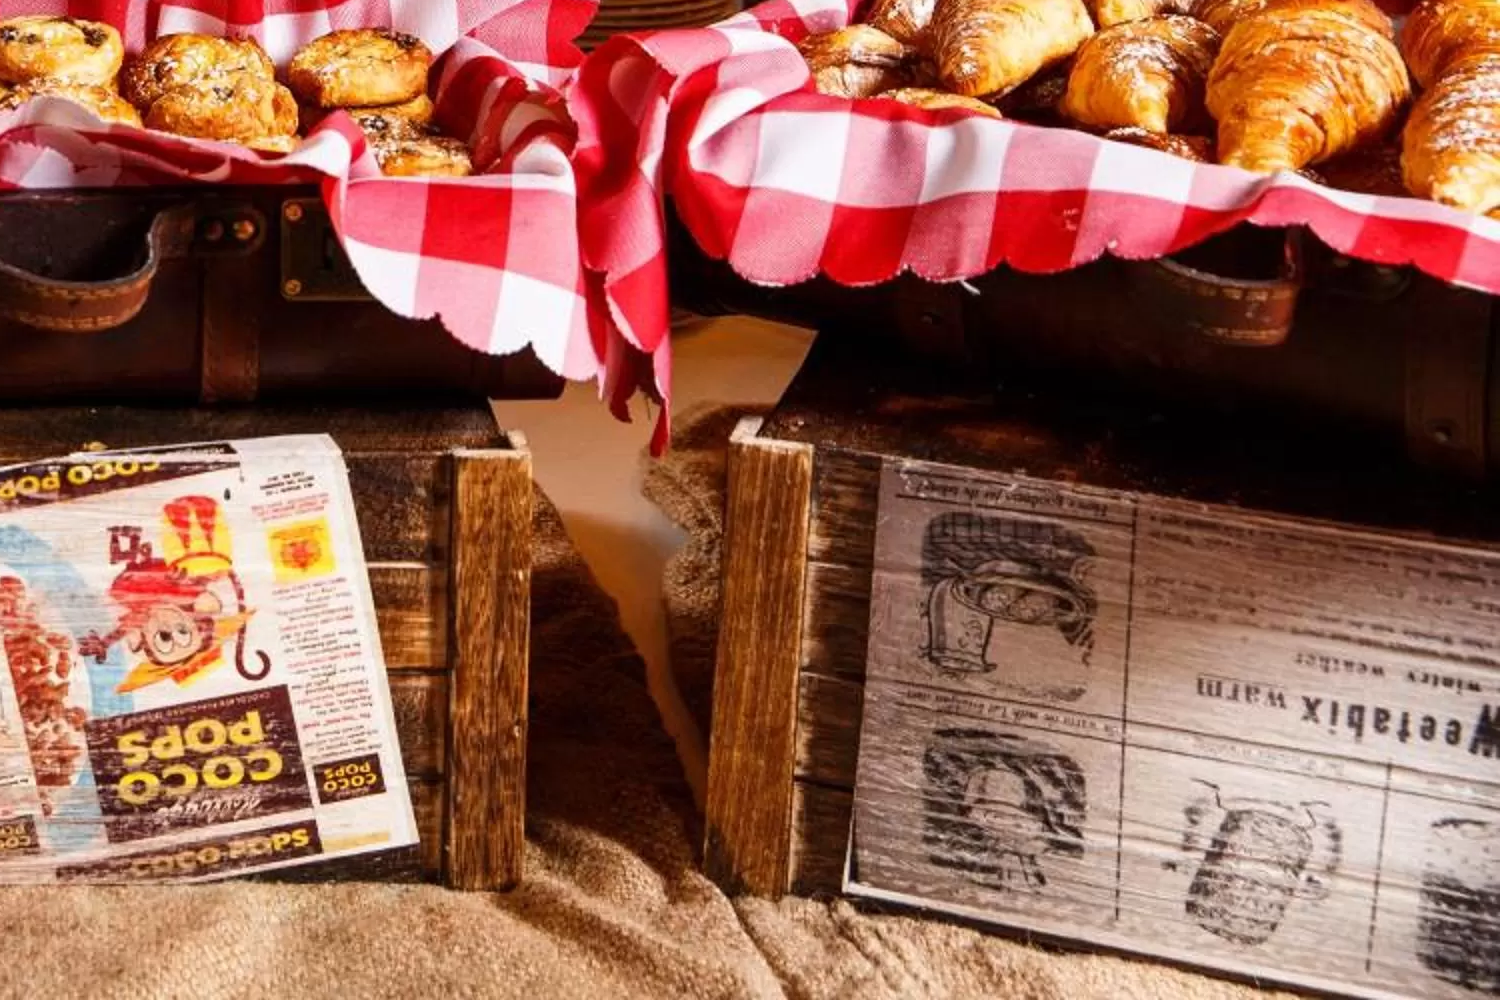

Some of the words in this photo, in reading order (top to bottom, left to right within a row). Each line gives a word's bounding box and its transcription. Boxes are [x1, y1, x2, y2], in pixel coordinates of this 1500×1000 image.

[1294, 653, 1385, 679] weather
[1196, 678, 1287, 710] warm
[115, 709, 265, 766] POPS
[1301, 695, 1500, 761] Weetabix
[117, 747, 283, 806] COCO
[324, 761, 371, 780] POPS
[324, 773, 378, 793] COCO
